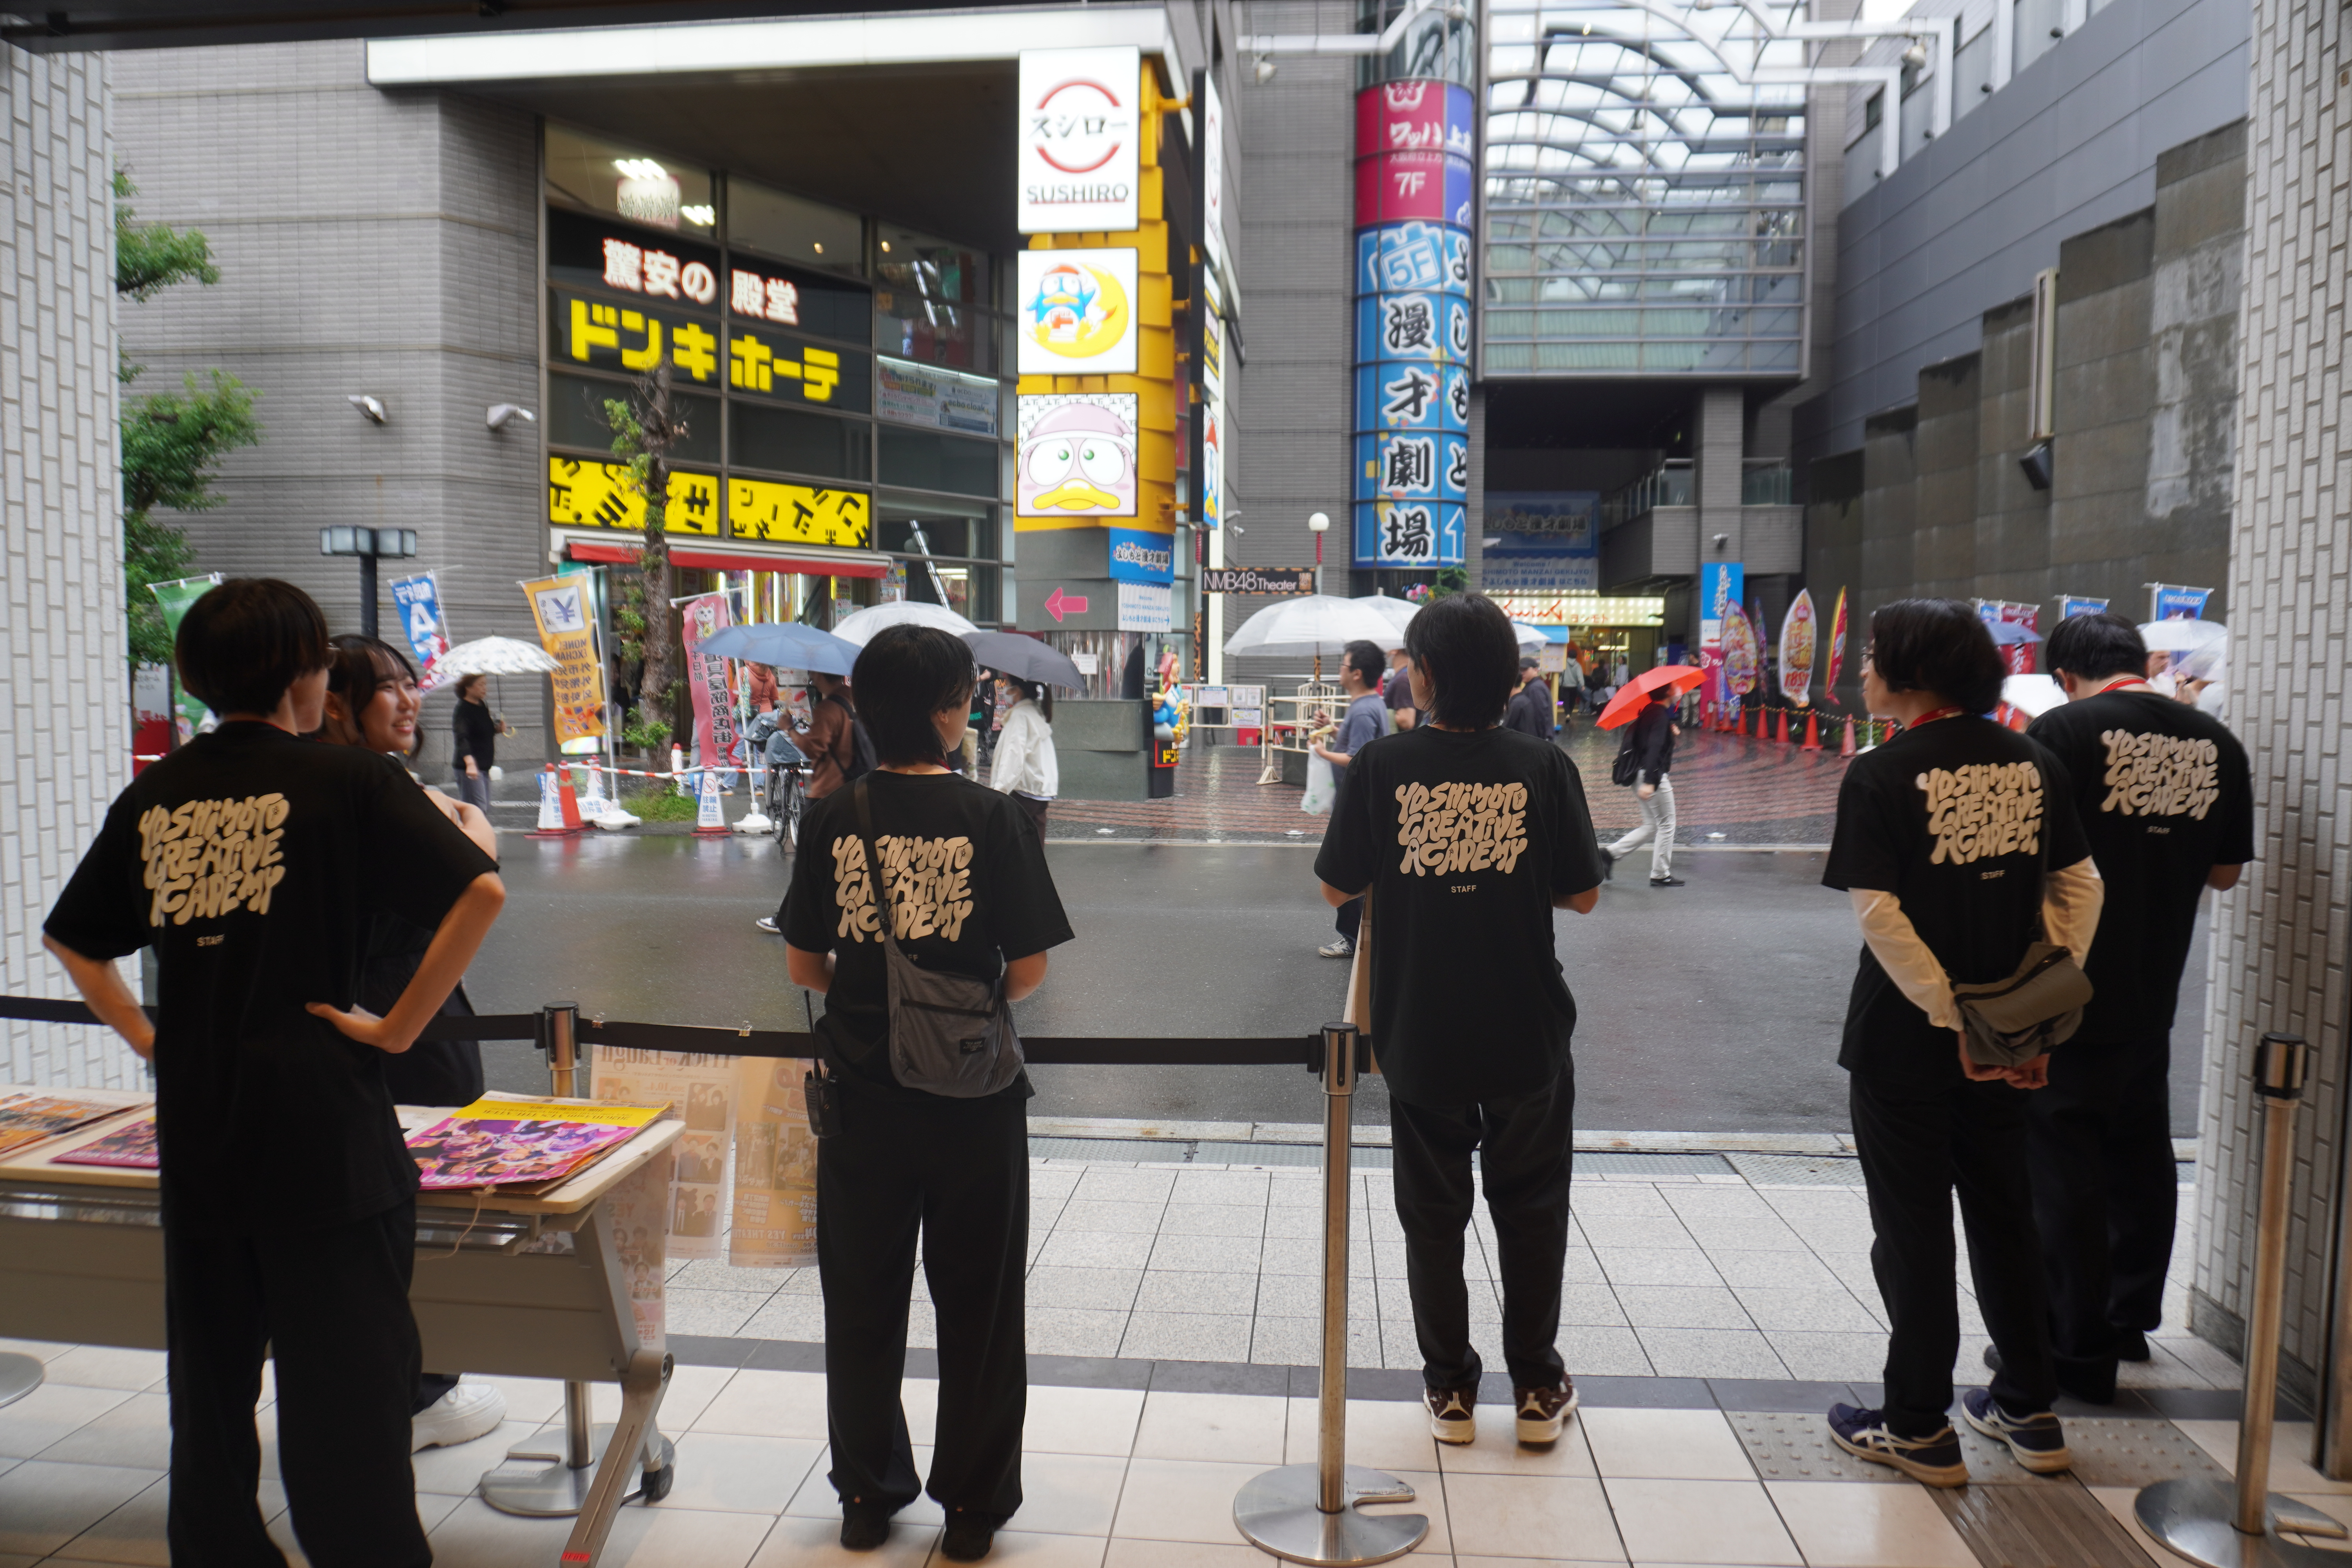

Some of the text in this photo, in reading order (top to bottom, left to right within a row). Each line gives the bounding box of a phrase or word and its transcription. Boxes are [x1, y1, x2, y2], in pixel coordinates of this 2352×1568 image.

[1029, 114, 1129, 138] スシロー
[1026, 183, 1129, 202] SUSHIRO
[1394, 172, 1426, 199] 7F
[1388, 240, 1431, 286] 5F
[1385, 302, 1432, 557] 漫才劇場
[1116, 548, 1169, 565] よしもと漫才劇場
[1204, 571, 1297, 591] NMB48 Theater
[2100, 779, 2220, 821] ACADEMY
[2146, 826, 2171, 835] STAFF
[1399, 838, 1528, 877] ACADEMY
[1980, 869, 2006, 880] STAFF
[1451, 885, 1477, 893] STAFF
[196, 934, 225, 947] STAFF
